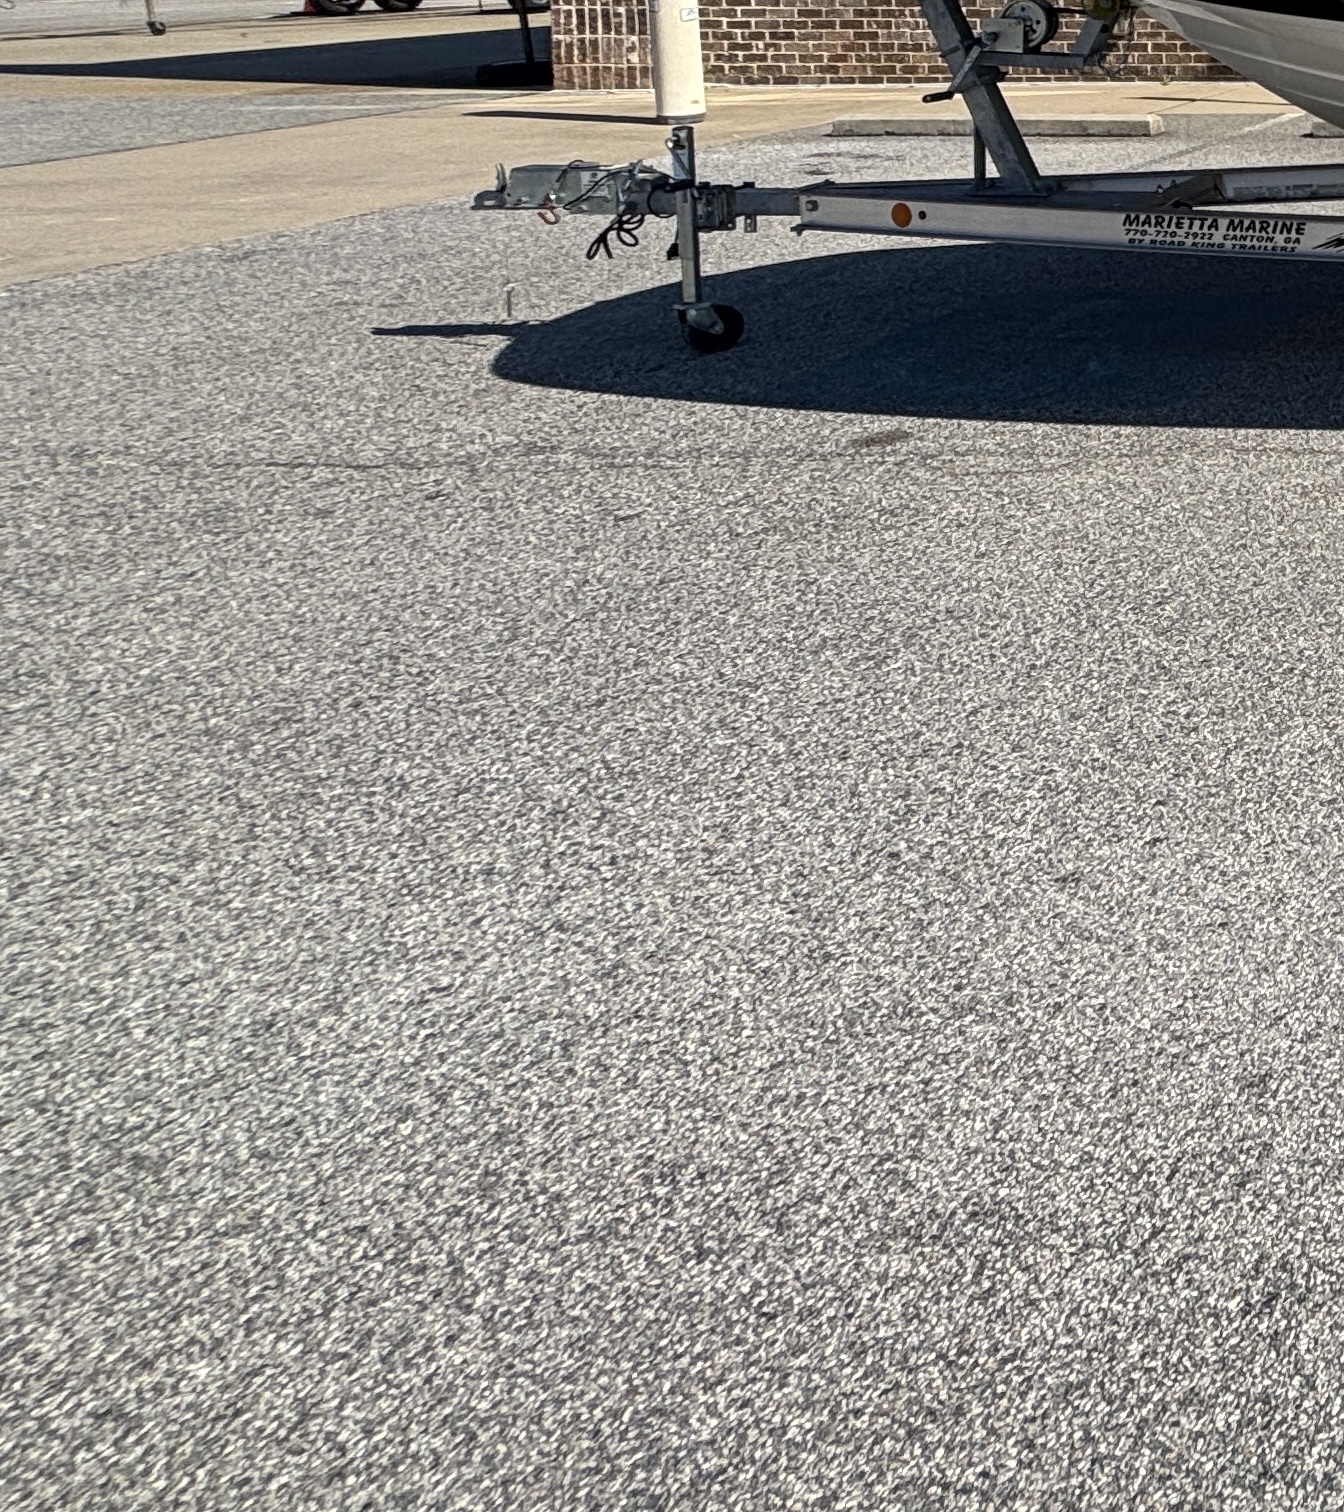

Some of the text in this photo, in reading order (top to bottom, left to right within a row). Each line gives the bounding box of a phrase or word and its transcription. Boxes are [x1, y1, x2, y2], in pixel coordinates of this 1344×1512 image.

[1122, 213, 1307, 236] MARIETTA MARINE
[1150, 239, 1186, 247] ROAD
[1190, 241, 1225, 249] KING
[1231, 243, 1298, 253] TRAILERS
[1284, 237, 1301, 245] GA
